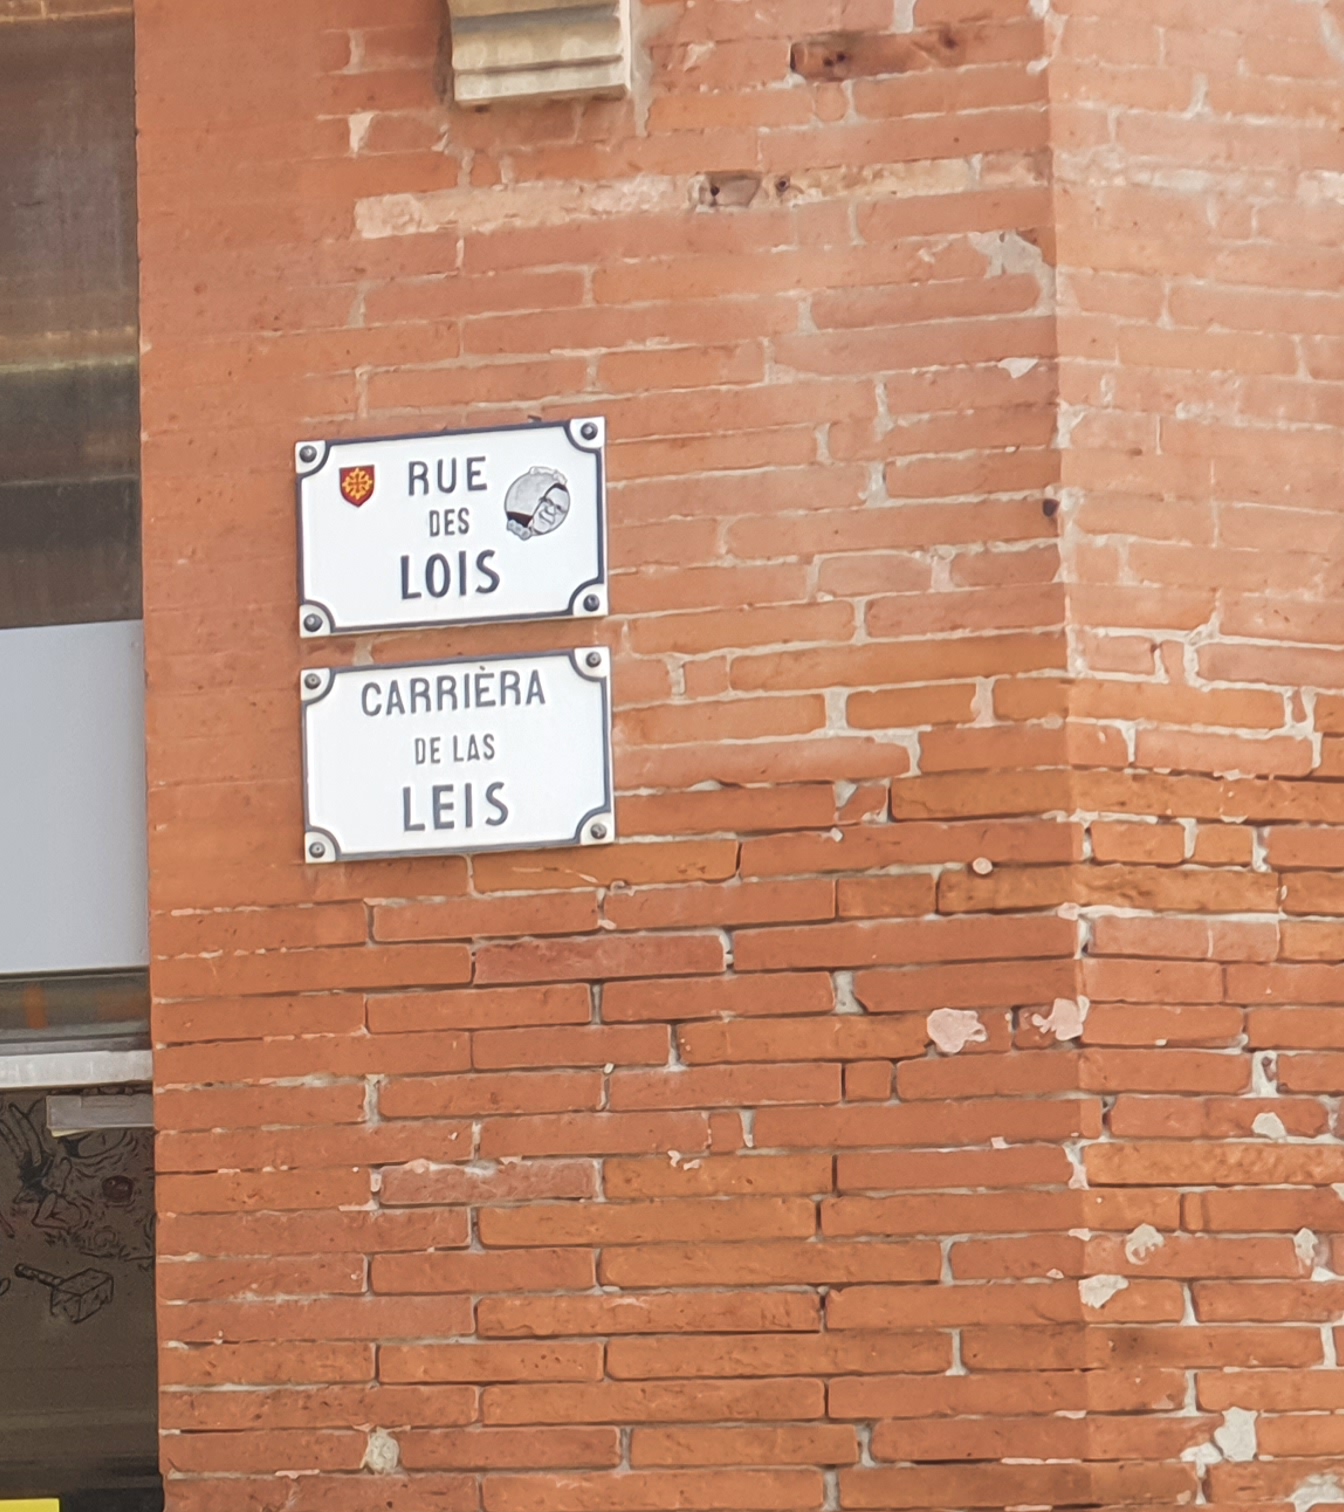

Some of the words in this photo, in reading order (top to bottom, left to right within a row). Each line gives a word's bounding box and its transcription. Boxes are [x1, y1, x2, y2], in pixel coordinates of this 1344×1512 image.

[408, 456, 487, 496] RUE
[429, 508, 470, 537] DES
[400, 549, 500, 600] LOIS
[361, 666, 546, 716] CARRIÈRA
[415, 736, 441, 765] DE
[453, 733, 495, 762] LAS
[402, 781, 509, 832] LEIS
